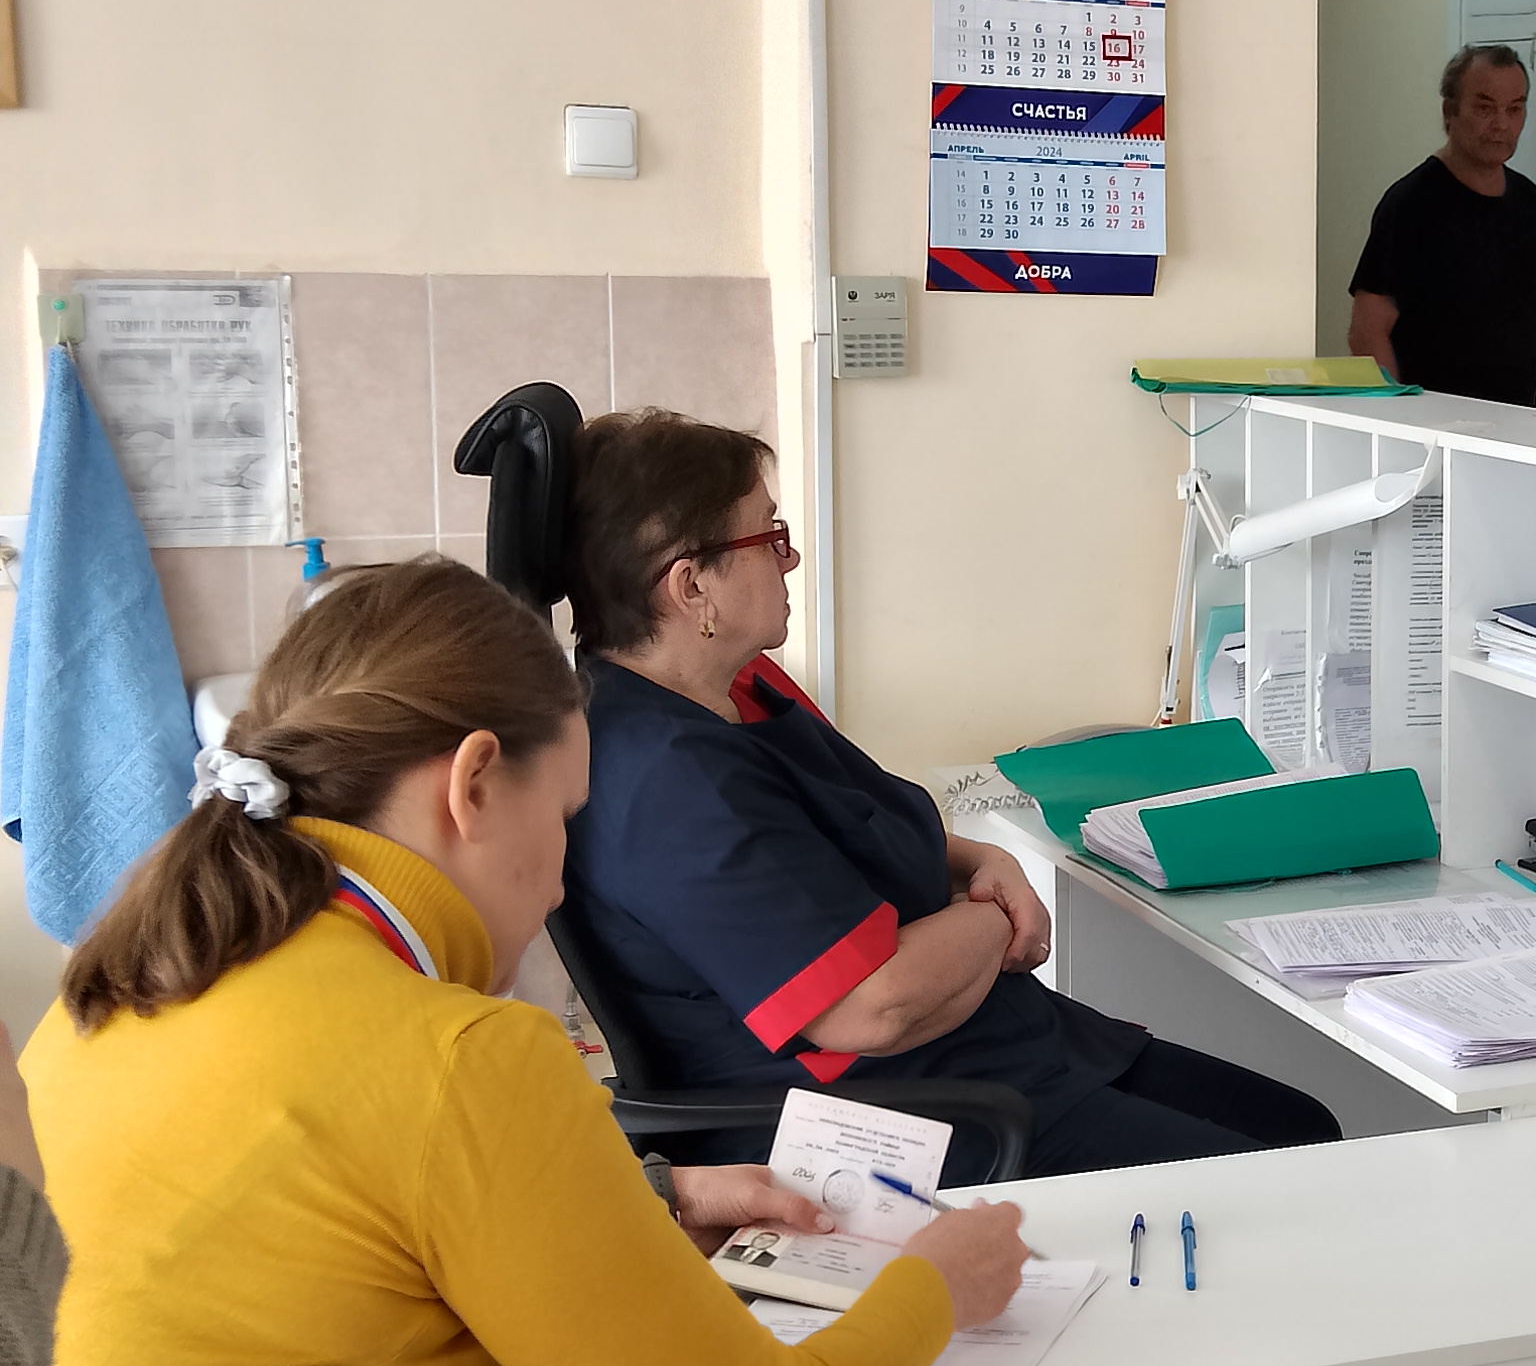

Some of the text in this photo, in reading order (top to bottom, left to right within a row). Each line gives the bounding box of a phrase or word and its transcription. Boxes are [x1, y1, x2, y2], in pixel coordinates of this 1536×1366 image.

[1086, 12, 1091, 23] 1
[1110, 14, 1117, 24] 2
[1134, 16, 1141, 26] 3
[984, 20, 991, 30] 4
[1009, 22, 1017, 32] 5
[1035, 23, 1042, 34] 6
[1060, 25, 1067, 35] 7
[1086, 27, 1092, 37] 8
[1132, 30, 1145, 40] 10
[981, 35, 993, 46] 11
[1007, 36, 1020, 47] 12
[1032, 38, 1045, 49] 13
[1058, 40, 1071, 50] 14
[1083, 41, 1096, 52] 15
[1108, 43, 1121, 53] 16
[1132, 45, 1145, 55] 17
[981, 50, 995, 60] 18
[1006, 51, 1020, 62] 19
[1031, 52, 1046, 63] 20
[1057, 54, 1070, 65] 21
[1082, 56, 1096, 66] 22
[1131, 59, 1145, 69] 24
[980, 65, 995, 75] 25
[1006, 66, 1020, 76] 26
[1031, 67, 1046, 78] 27
[1057, 69, 1071, 79] 28
[1082, 70, 1096, 80] 29
[1107, 72, 1121, 82] 30
[1131, 73, 1144, 83] 31
[1012, 103, 1087, 121] СЧАСТЬЯ
[947, 144, 1150, 161] АПРЕЛЬ 2024 APRIL
[983, 170, 989, 180] 1
[1007, 171, 1015, 182] 2
[1033, 173, 1040, 183] 3
[1058, 174, 1066, 184] 4
[1084, 175, 1091, 185] 5
[1109, 176, 1116, 186] 6
[1134, 177, 1141, 186] 7
[983, 185, 990, 195] 8
[1008, 186, 1015, 196] 9
[1031, 187, 1044, 197] 10
[1056, 188, 1068, 198] 11
[1081, 189, 1094, 199] 12
[1107, 190, 1119, 200] 13
[1131, 191, 1145, 201] 14
[980, 199, 993, 209] 15
[1005, 200, 1019, 211] 16
[1031, 201, 1044, 212] 17
[1056, 202, 1069, 212] 18
[1081, 204, 1095, 213] 19
[1106, 205, 1120, 214] 20
[1131, 206, 1144, 215] 21
[979, 214, 994, 224] 22
[1004, 215, 1019, 225] 23
[1029, 216, 1044, 226] 24
[1055, 217, 1069, 227] 25
[1080, 218, 1095, 228] 26
[1106, 219, 1120, 229] 27
[1131, 220, 1145, 229] 28
[980, 228, 994, 238] 29
[1004, 229, 1019, 239] 30
[1014, 264, 1072, 281] ДОБРА
[873, 291, 896, 299] ЗАРЯ
[229, 320, 252, 333] РУК
